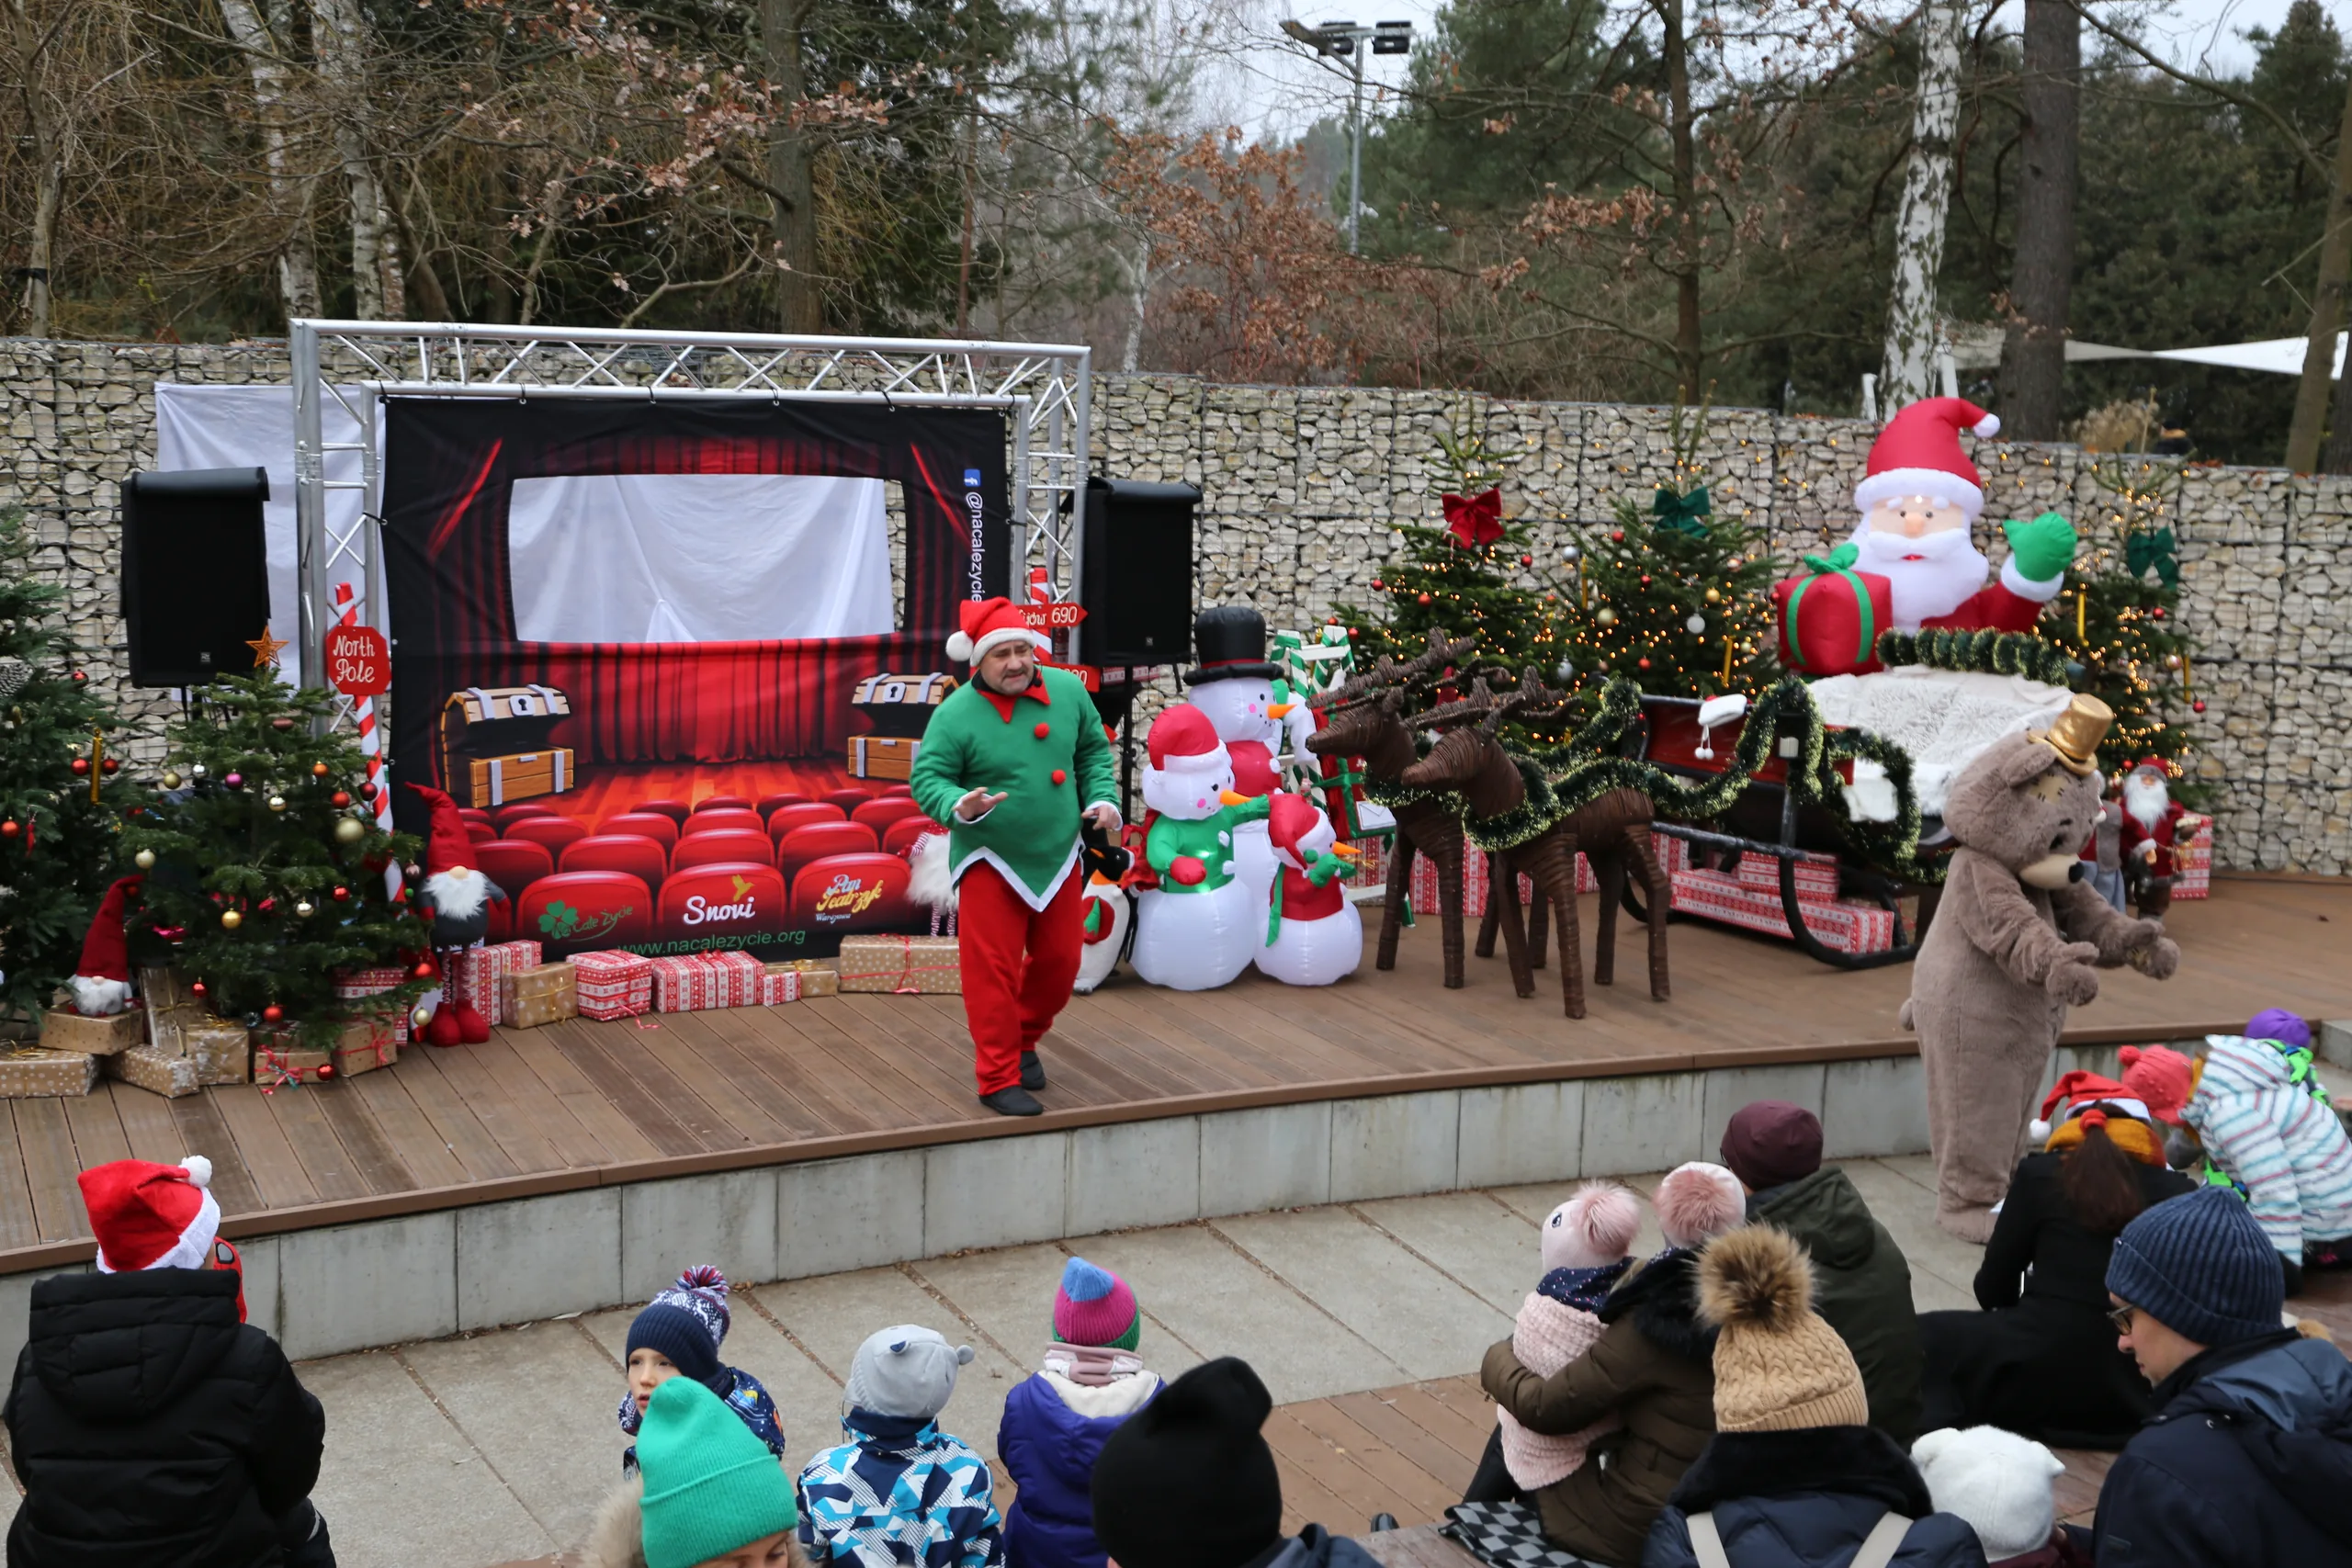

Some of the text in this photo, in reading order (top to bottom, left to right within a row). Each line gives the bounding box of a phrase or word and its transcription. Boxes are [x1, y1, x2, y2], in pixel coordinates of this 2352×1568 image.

[966, 491, 986, 603] @nacalezycie
[1051, 605, 1079, 624] 690
[333, 635, 376, 657] North
[335, 658, 375, 684] Pole
[816, 879, 885, 913] Teatrzyk
[826, 874, 862, 896] Pan
[683, 895, 756, 925] Snovi
